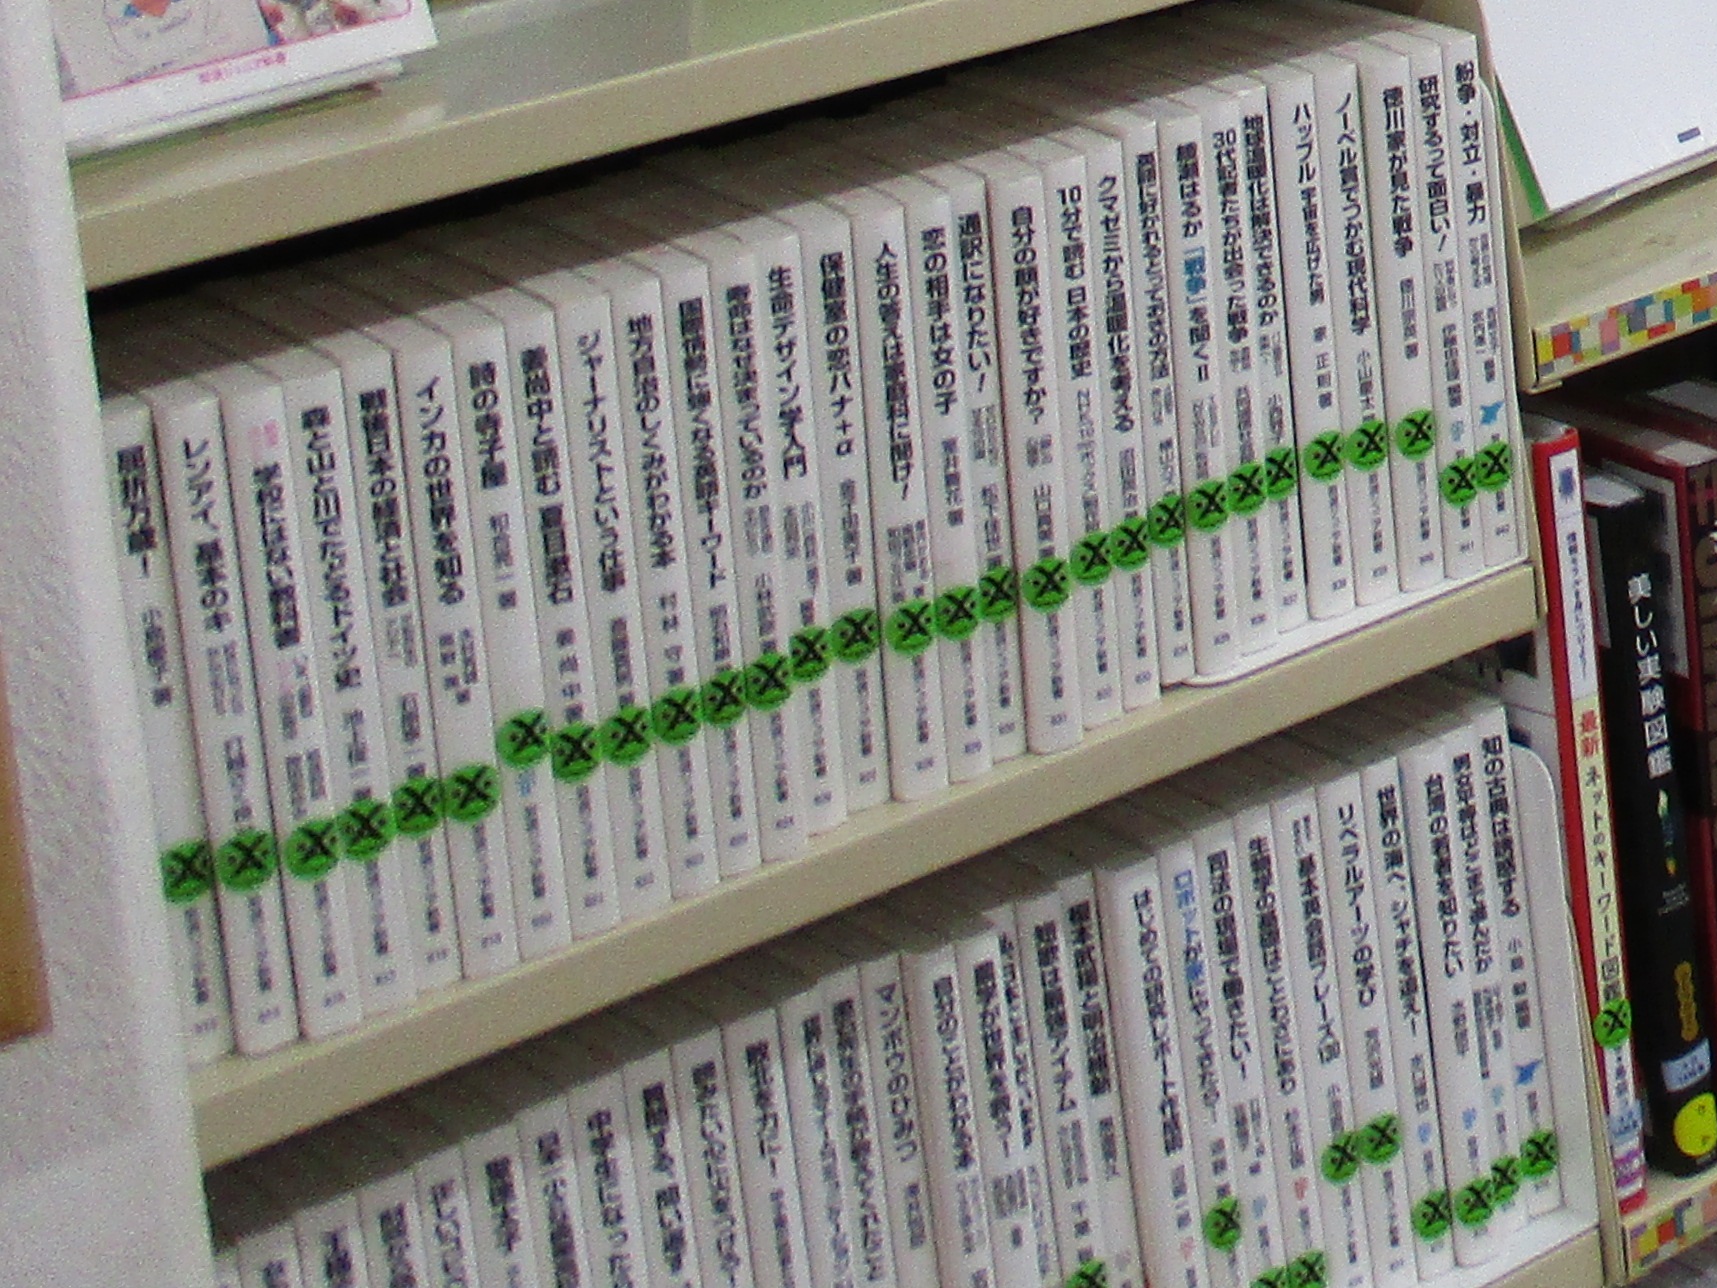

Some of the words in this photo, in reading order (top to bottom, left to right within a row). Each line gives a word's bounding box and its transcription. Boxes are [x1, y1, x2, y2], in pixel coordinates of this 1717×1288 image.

[1335, 92, 1373, 336] ノーベル賞でつかむ現代科学
[1382, 84, 1415, 258] 徳川家が見た戦争
[1454, 59, 1487, 227] 紛争・対立・暴力
[920, 225, 959, 418] 恋の相手は女の子
[1066, 285, 1093, 380] 日本の歴史
[1097, 174, 1135, 434] クマゼミから温暖化を考える
[1575, 708, 1604, 761] 最新
